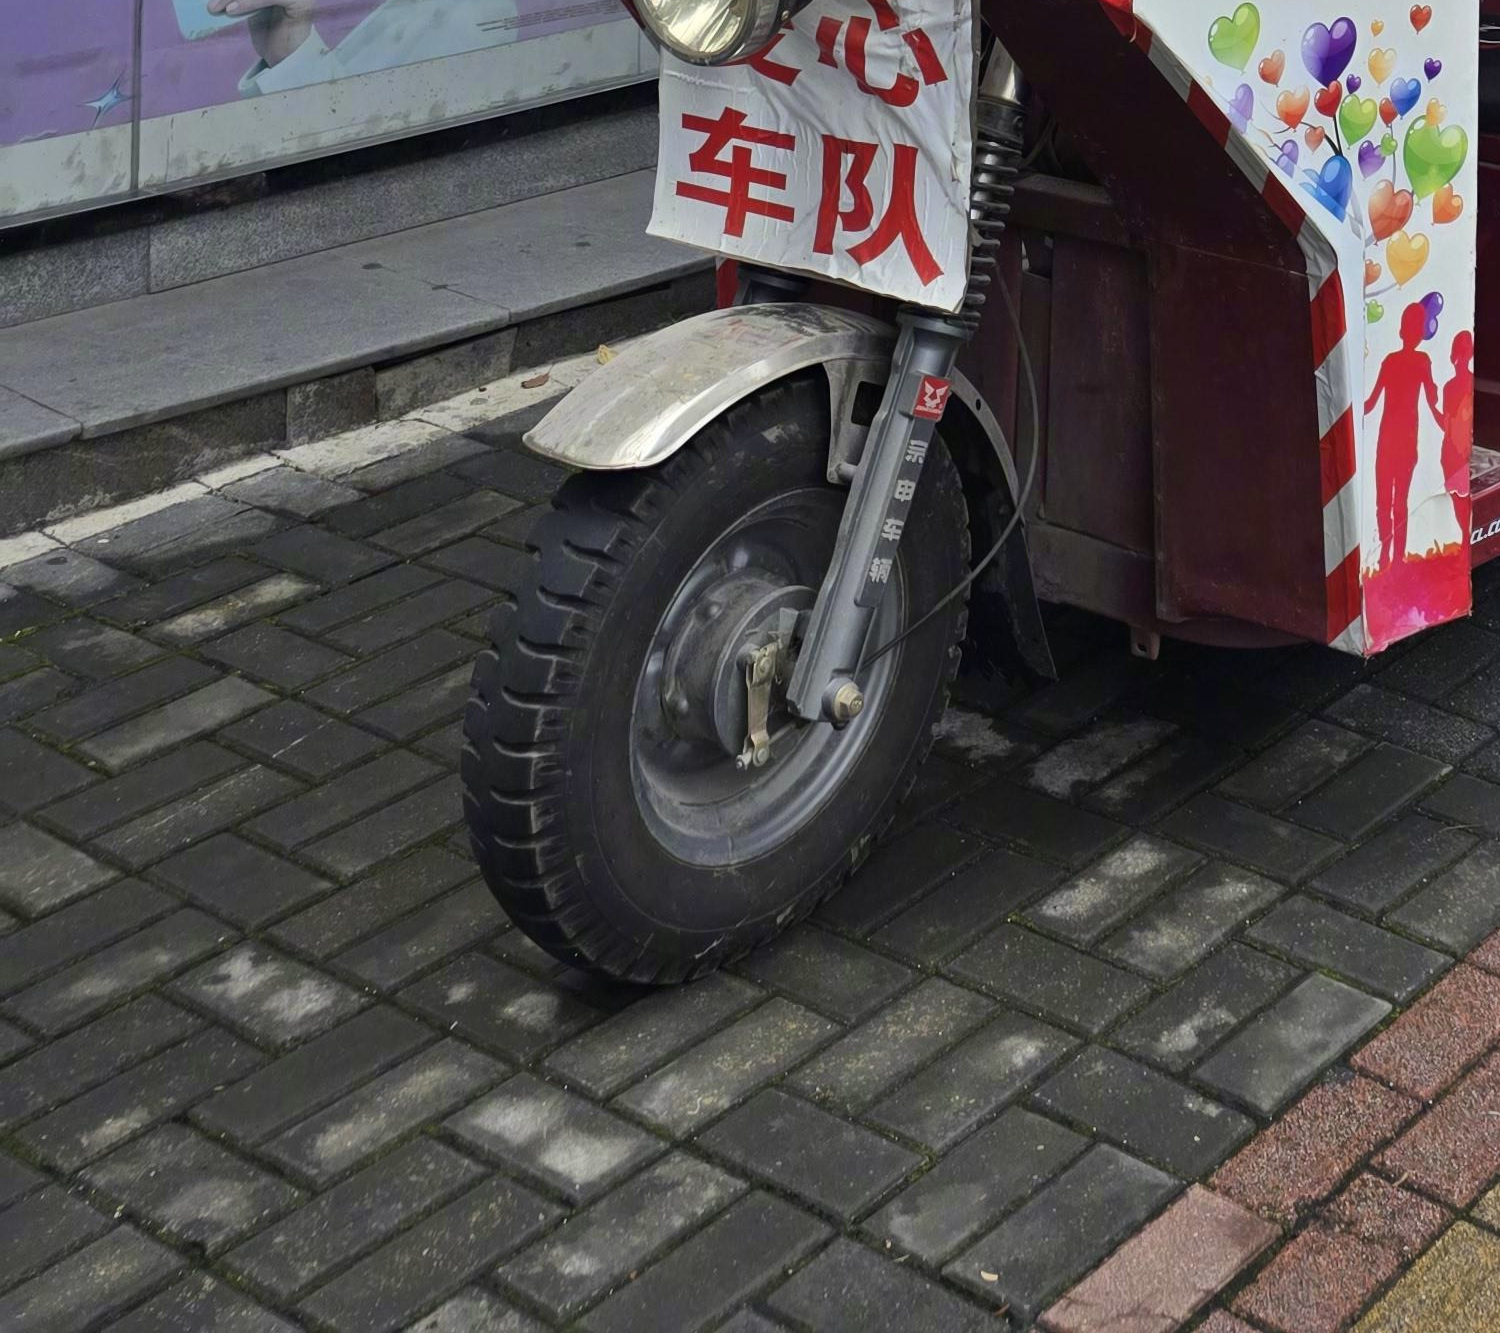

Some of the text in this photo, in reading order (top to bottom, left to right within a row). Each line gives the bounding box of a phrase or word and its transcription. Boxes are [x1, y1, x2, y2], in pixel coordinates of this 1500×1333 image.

[675, 106, 945, 287] 车队
[869, 439, 929, 583] 宗申车辆
